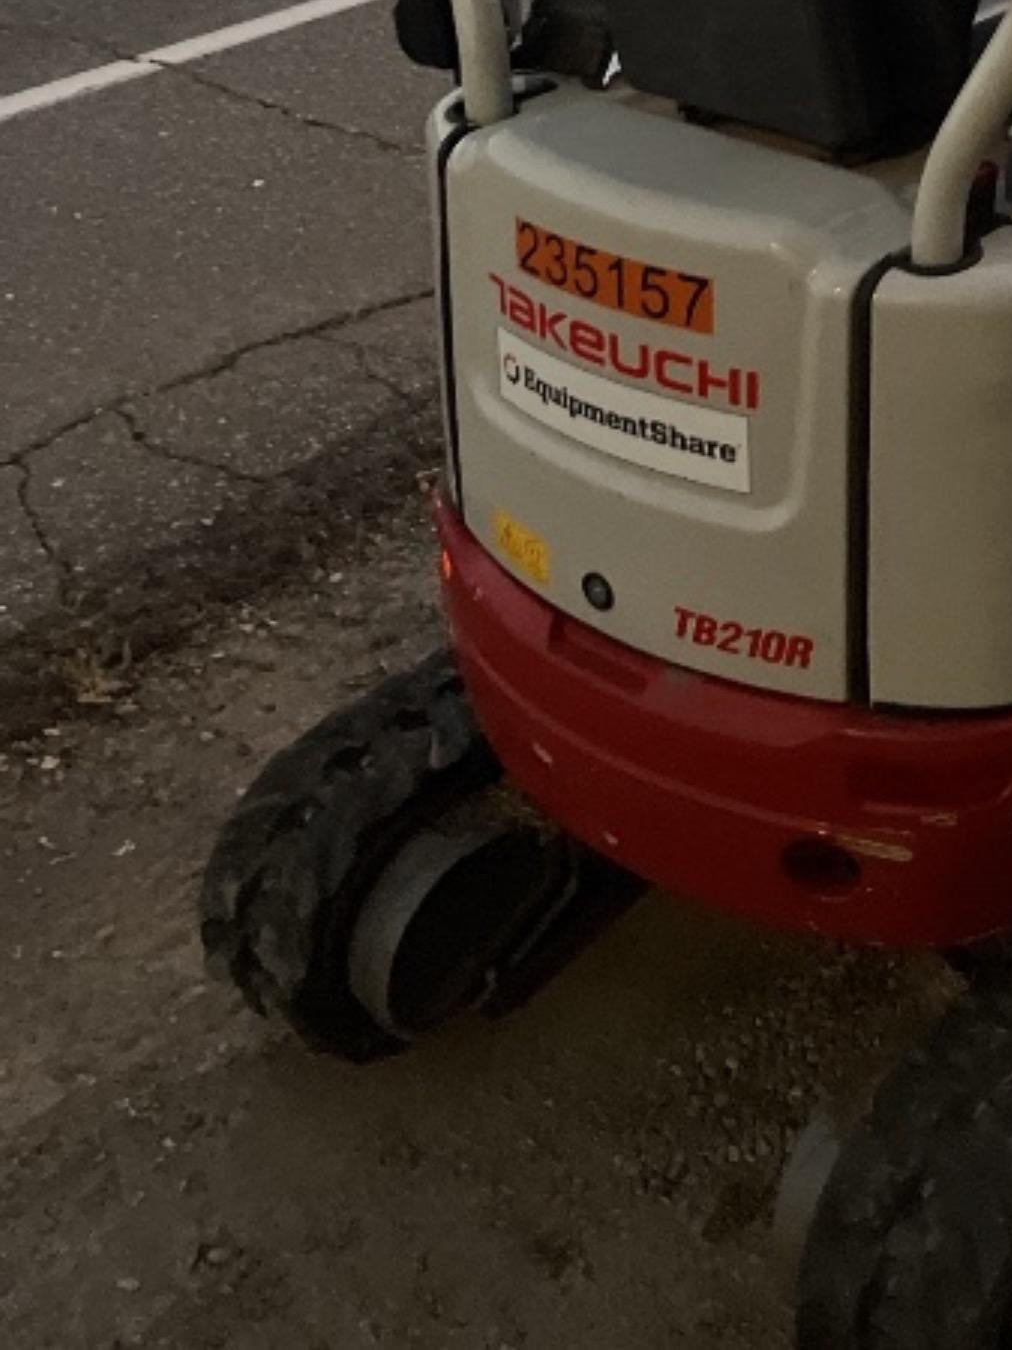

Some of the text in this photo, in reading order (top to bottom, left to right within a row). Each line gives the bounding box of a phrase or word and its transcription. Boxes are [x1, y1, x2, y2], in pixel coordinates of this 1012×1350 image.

[519, 221, 709, 327] 235157
[524, 365, 737, 463] EquipmentShare
[674, 606, 815, 668] TB210R
